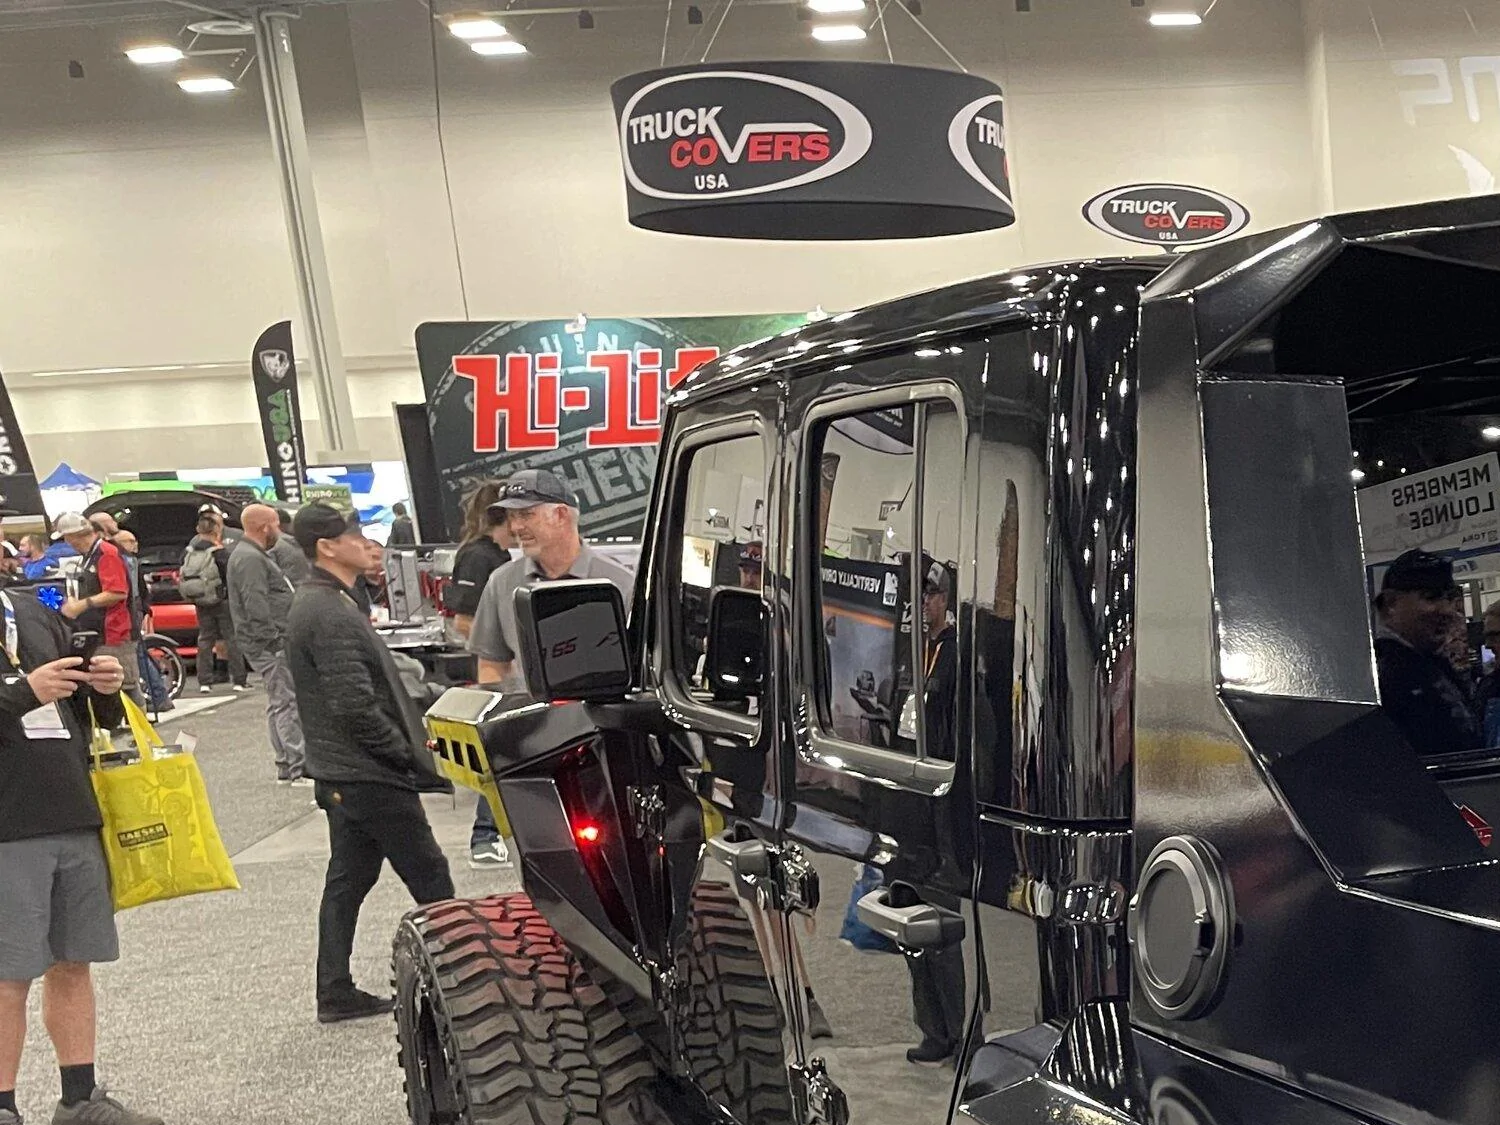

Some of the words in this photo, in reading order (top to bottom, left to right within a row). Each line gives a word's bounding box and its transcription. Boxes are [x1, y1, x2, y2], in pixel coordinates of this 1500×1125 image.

[629, 106, 723, 145] TRUCK
[670, 122, 830, 169] COVERS
[694, 173, 729, 190] USA
[1109, 199, 1177, 214] TRUCK
[1144, 211, 1226, 230] COVERS
[1158, 232, 1179, 240] USA
